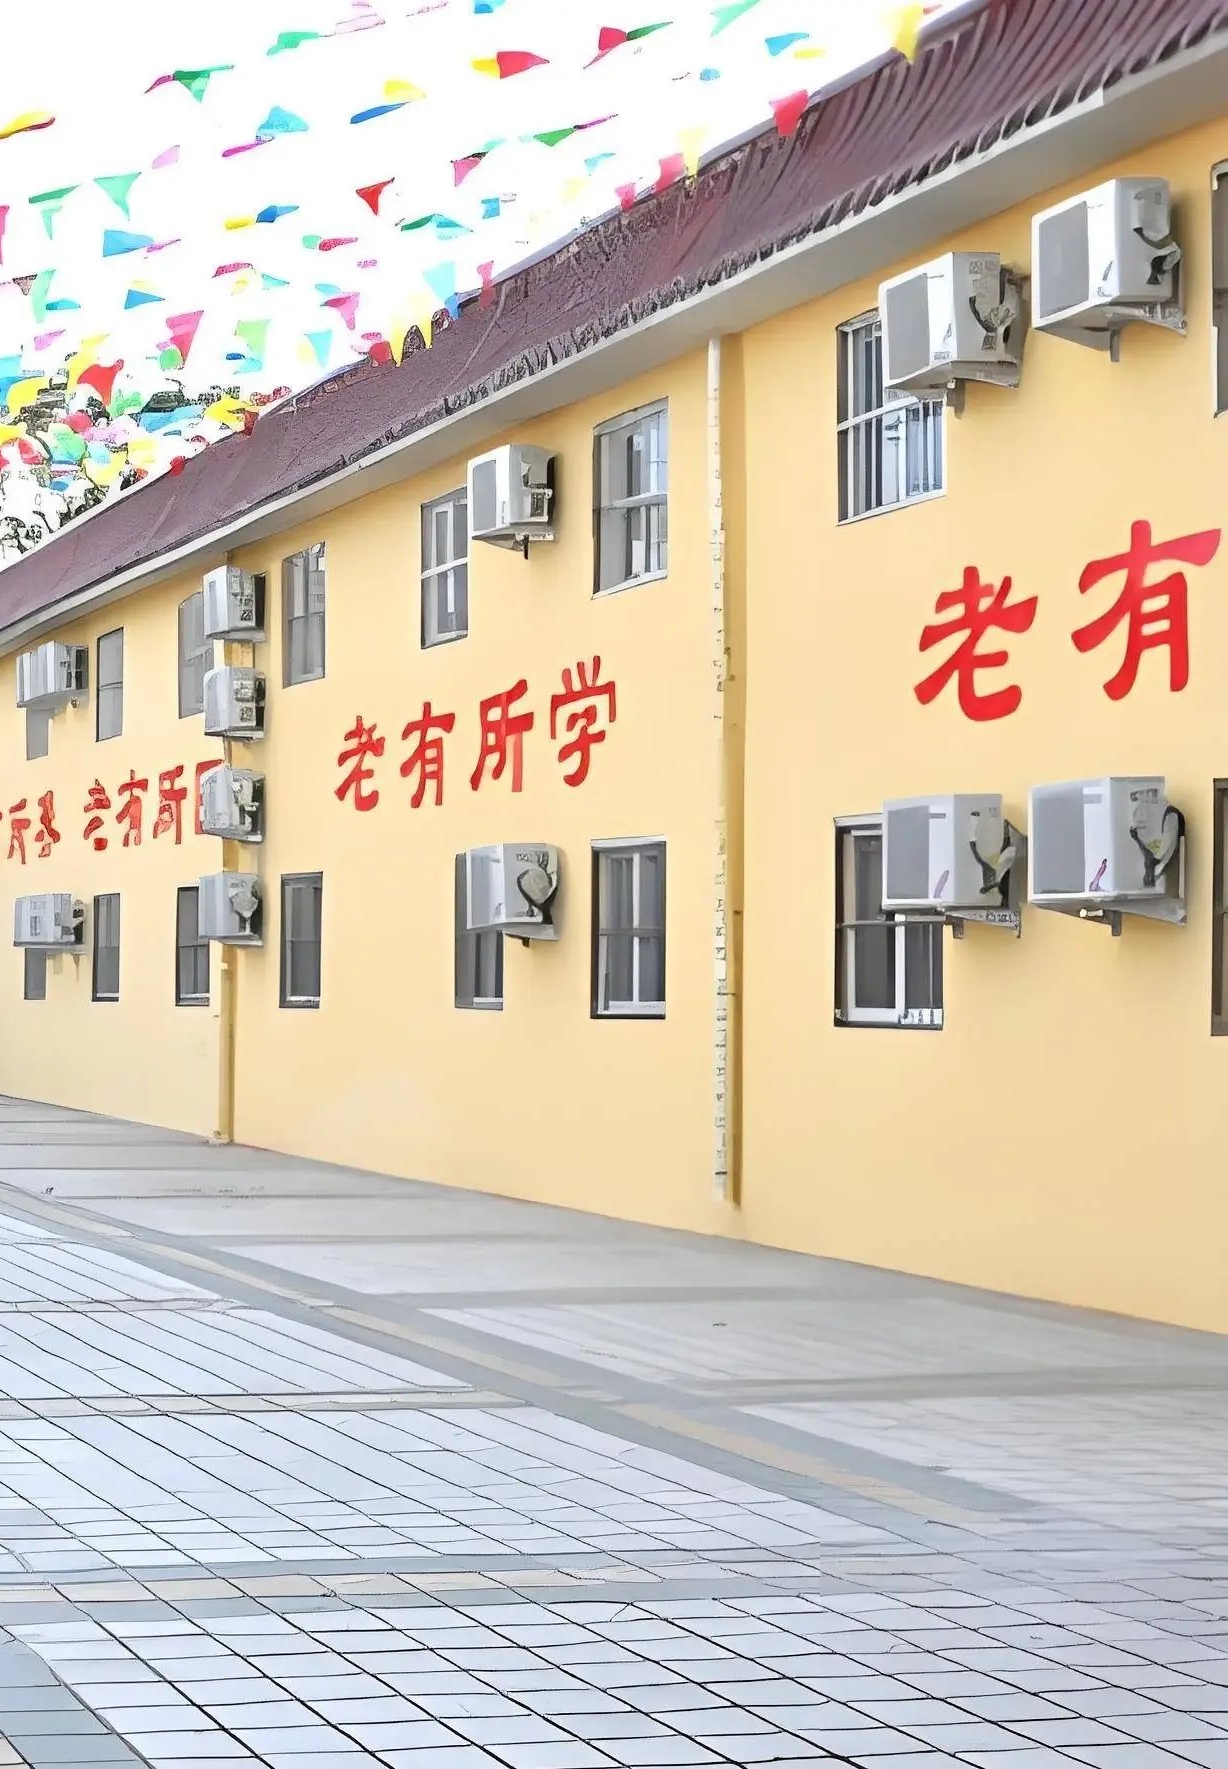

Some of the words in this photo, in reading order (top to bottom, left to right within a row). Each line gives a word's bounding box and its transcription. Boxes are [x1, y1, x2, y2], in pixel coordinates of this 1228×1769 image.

[914, 519, 1221, 723] 老有
[83, 758, 225, 851] 老有所
[334, 655, 617, 812] 老有所学
